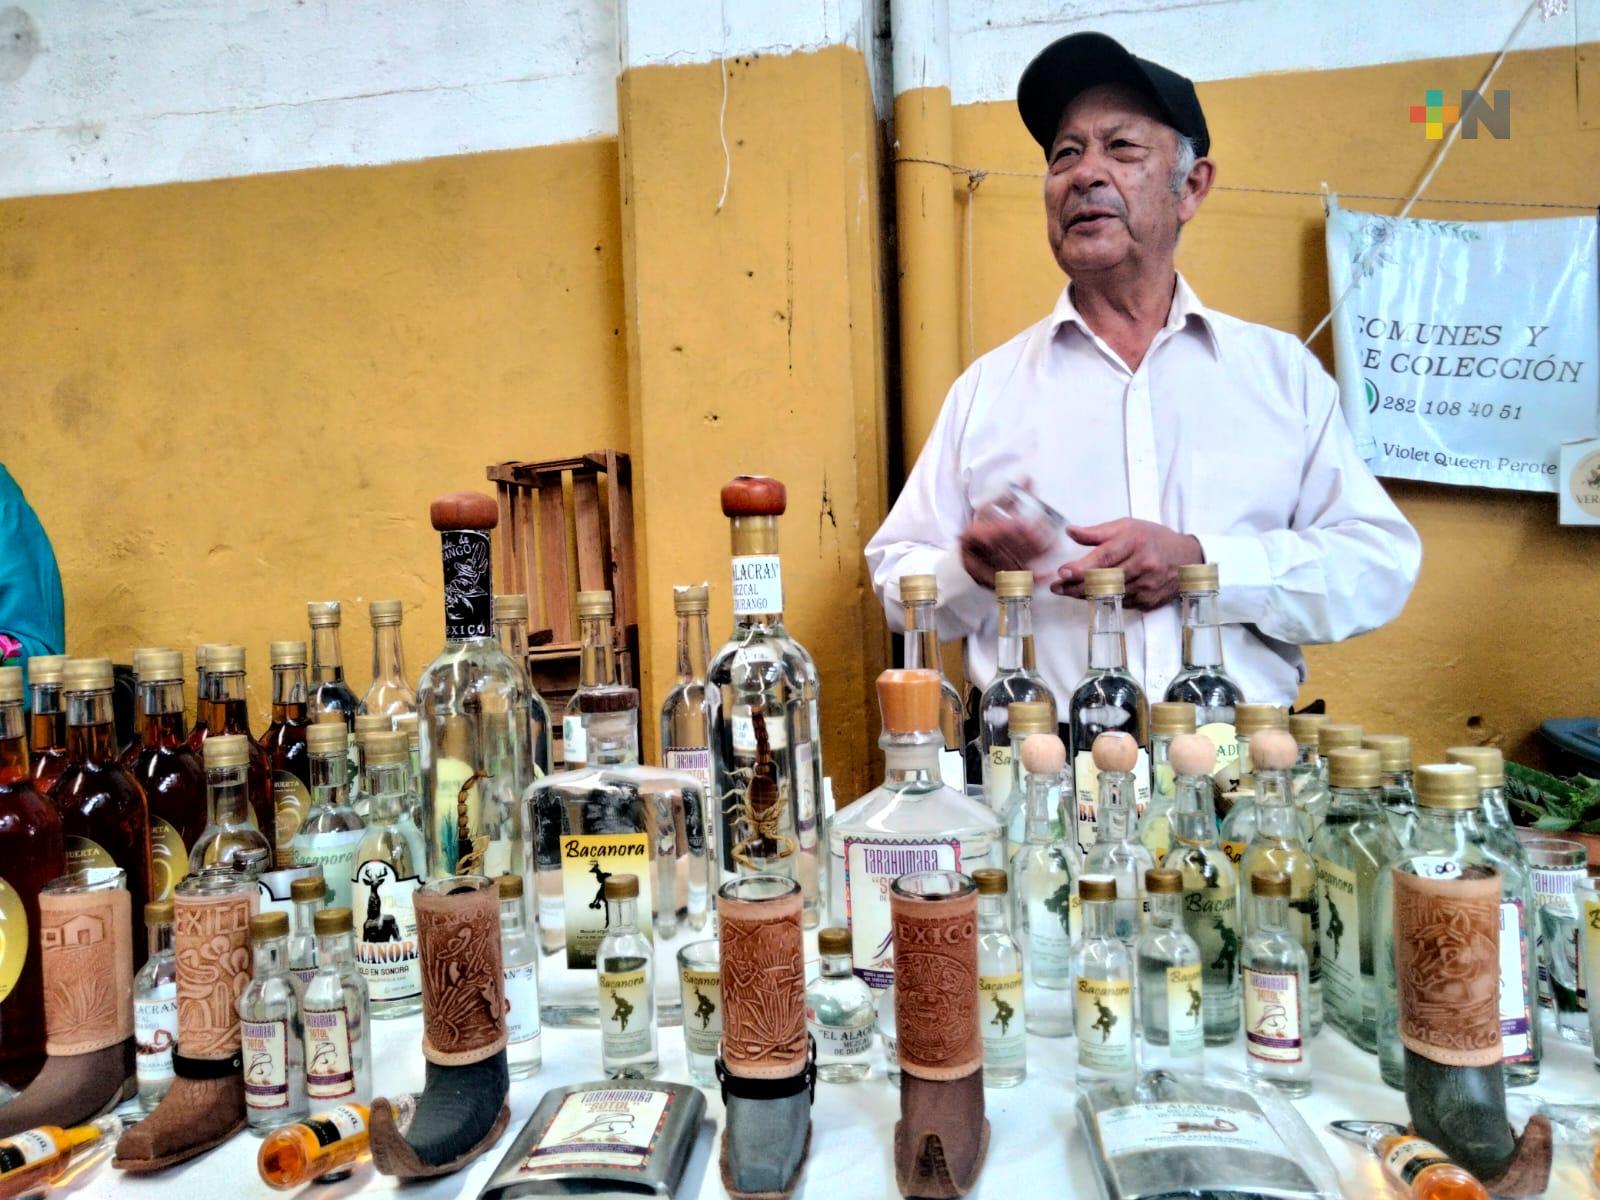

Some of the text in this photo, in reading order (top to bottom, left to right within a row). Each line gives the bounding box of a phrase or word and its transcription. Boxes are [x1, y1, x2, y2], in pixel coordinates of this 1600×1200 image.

[1527, 326, 1549, 348] Y
[1361, 348, 1584, 384] E COLECCIÓN
[1383, 396, 1522, 420] 282 108 40 51
[1384, 442, 1558, 475] Violet Queen Perote
[735, 583, 759, 596] EZCAL
[735, 598, 768, 611] URANGO
[564, 840, 645, 858] Bacanora
[863, 848, 939, 875] TARAHUMARA
[898, 921, 974, 946] EXICO
[381, 966, 410, 976] SONORA
[600, 976, 644, 988] Bacanora
[1407, 1021, 1498, 1051] MEXICO
